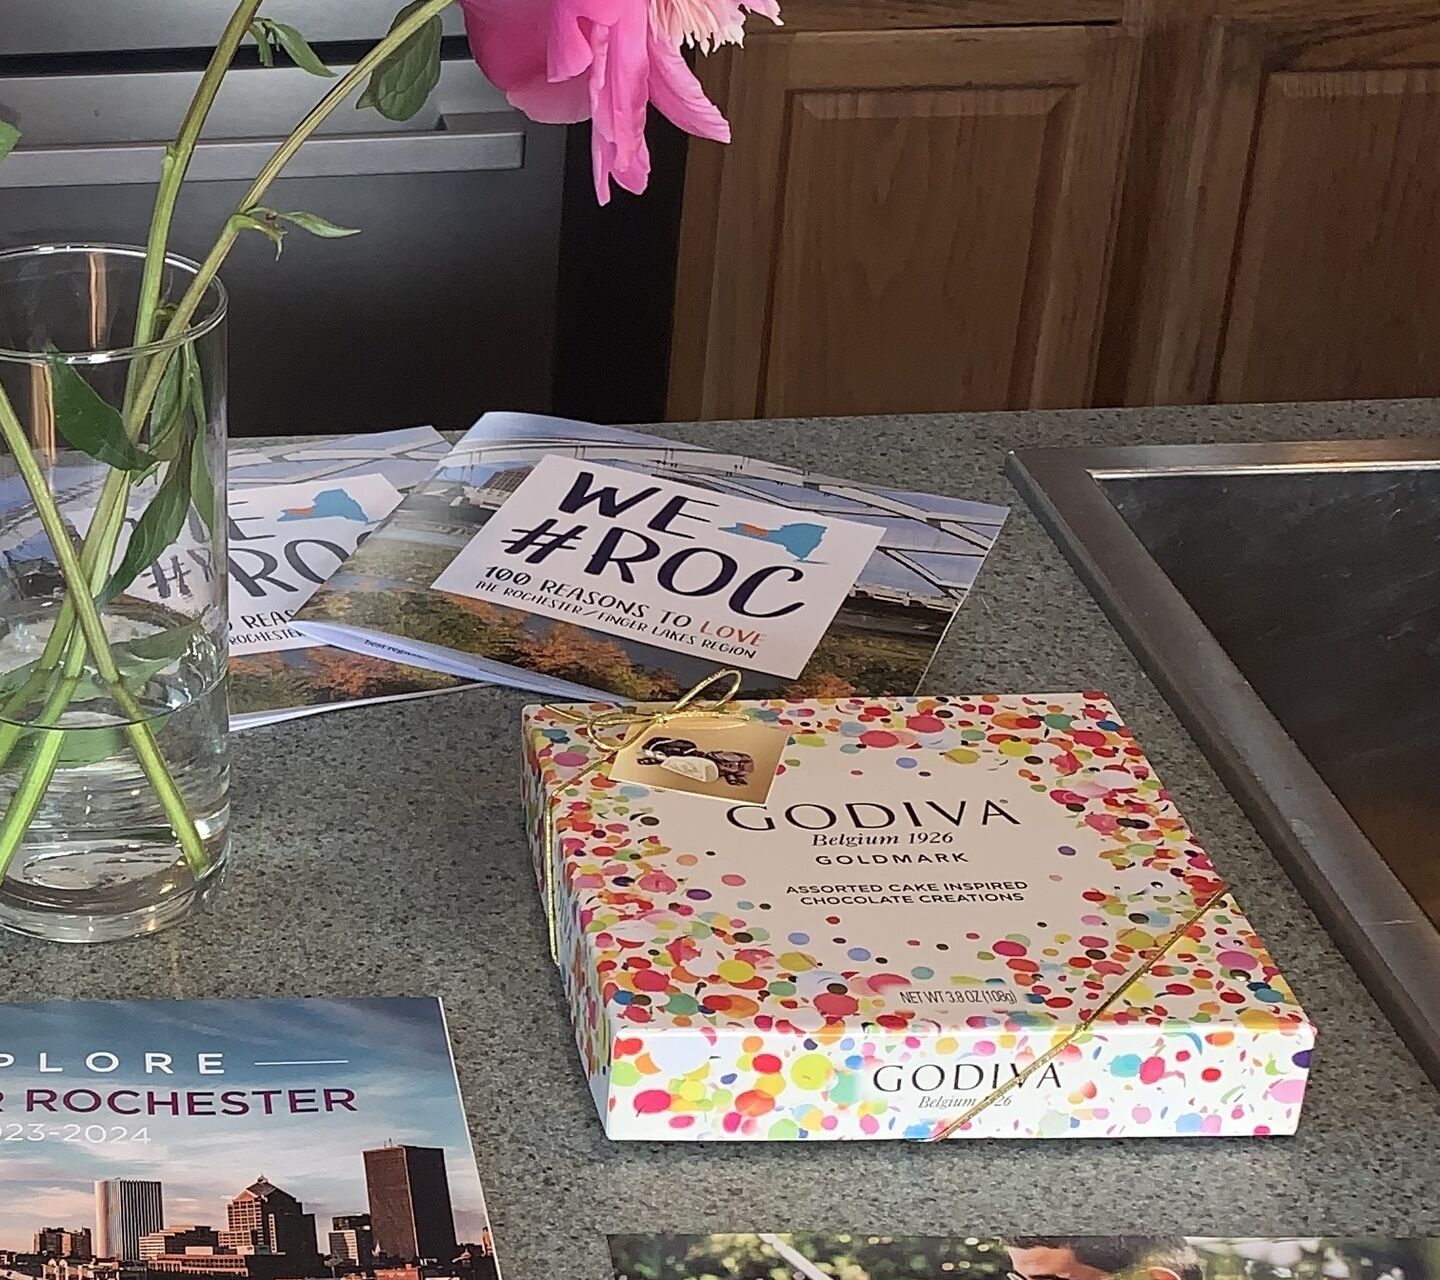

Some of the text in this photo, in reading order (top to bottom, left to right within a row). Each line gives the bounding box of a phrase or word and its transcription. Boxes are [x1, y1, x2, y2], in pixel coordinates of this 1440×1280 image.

[558, 471, 720, 539] WE
[499, 518, 806, 618] #ROC
[484, 565, 766, 647] 100 REASONS TO LOVE
[474, 581, 500, 595] THE
[651, 625, 696, 645] LAKES
[701, 639, 757, 659] REGION
[726, 799, 1021, 831] GODIVA
[812, 831, 954, 848] Belgium 1926
[815, 852, 969, 866] GOLDMARK
[785, 880, 1028, 895] ASSORTED CAKE INSPIRED
[800, 892, 1025, 906] CHOCOLATE CREATIONS
[899, 988, 1018, 1006] NET WT 3.8 OZ (108g)
[25, 1087, 357, 1117] ROCHESTER
[918, 1095, 978, 1110] Belgium
